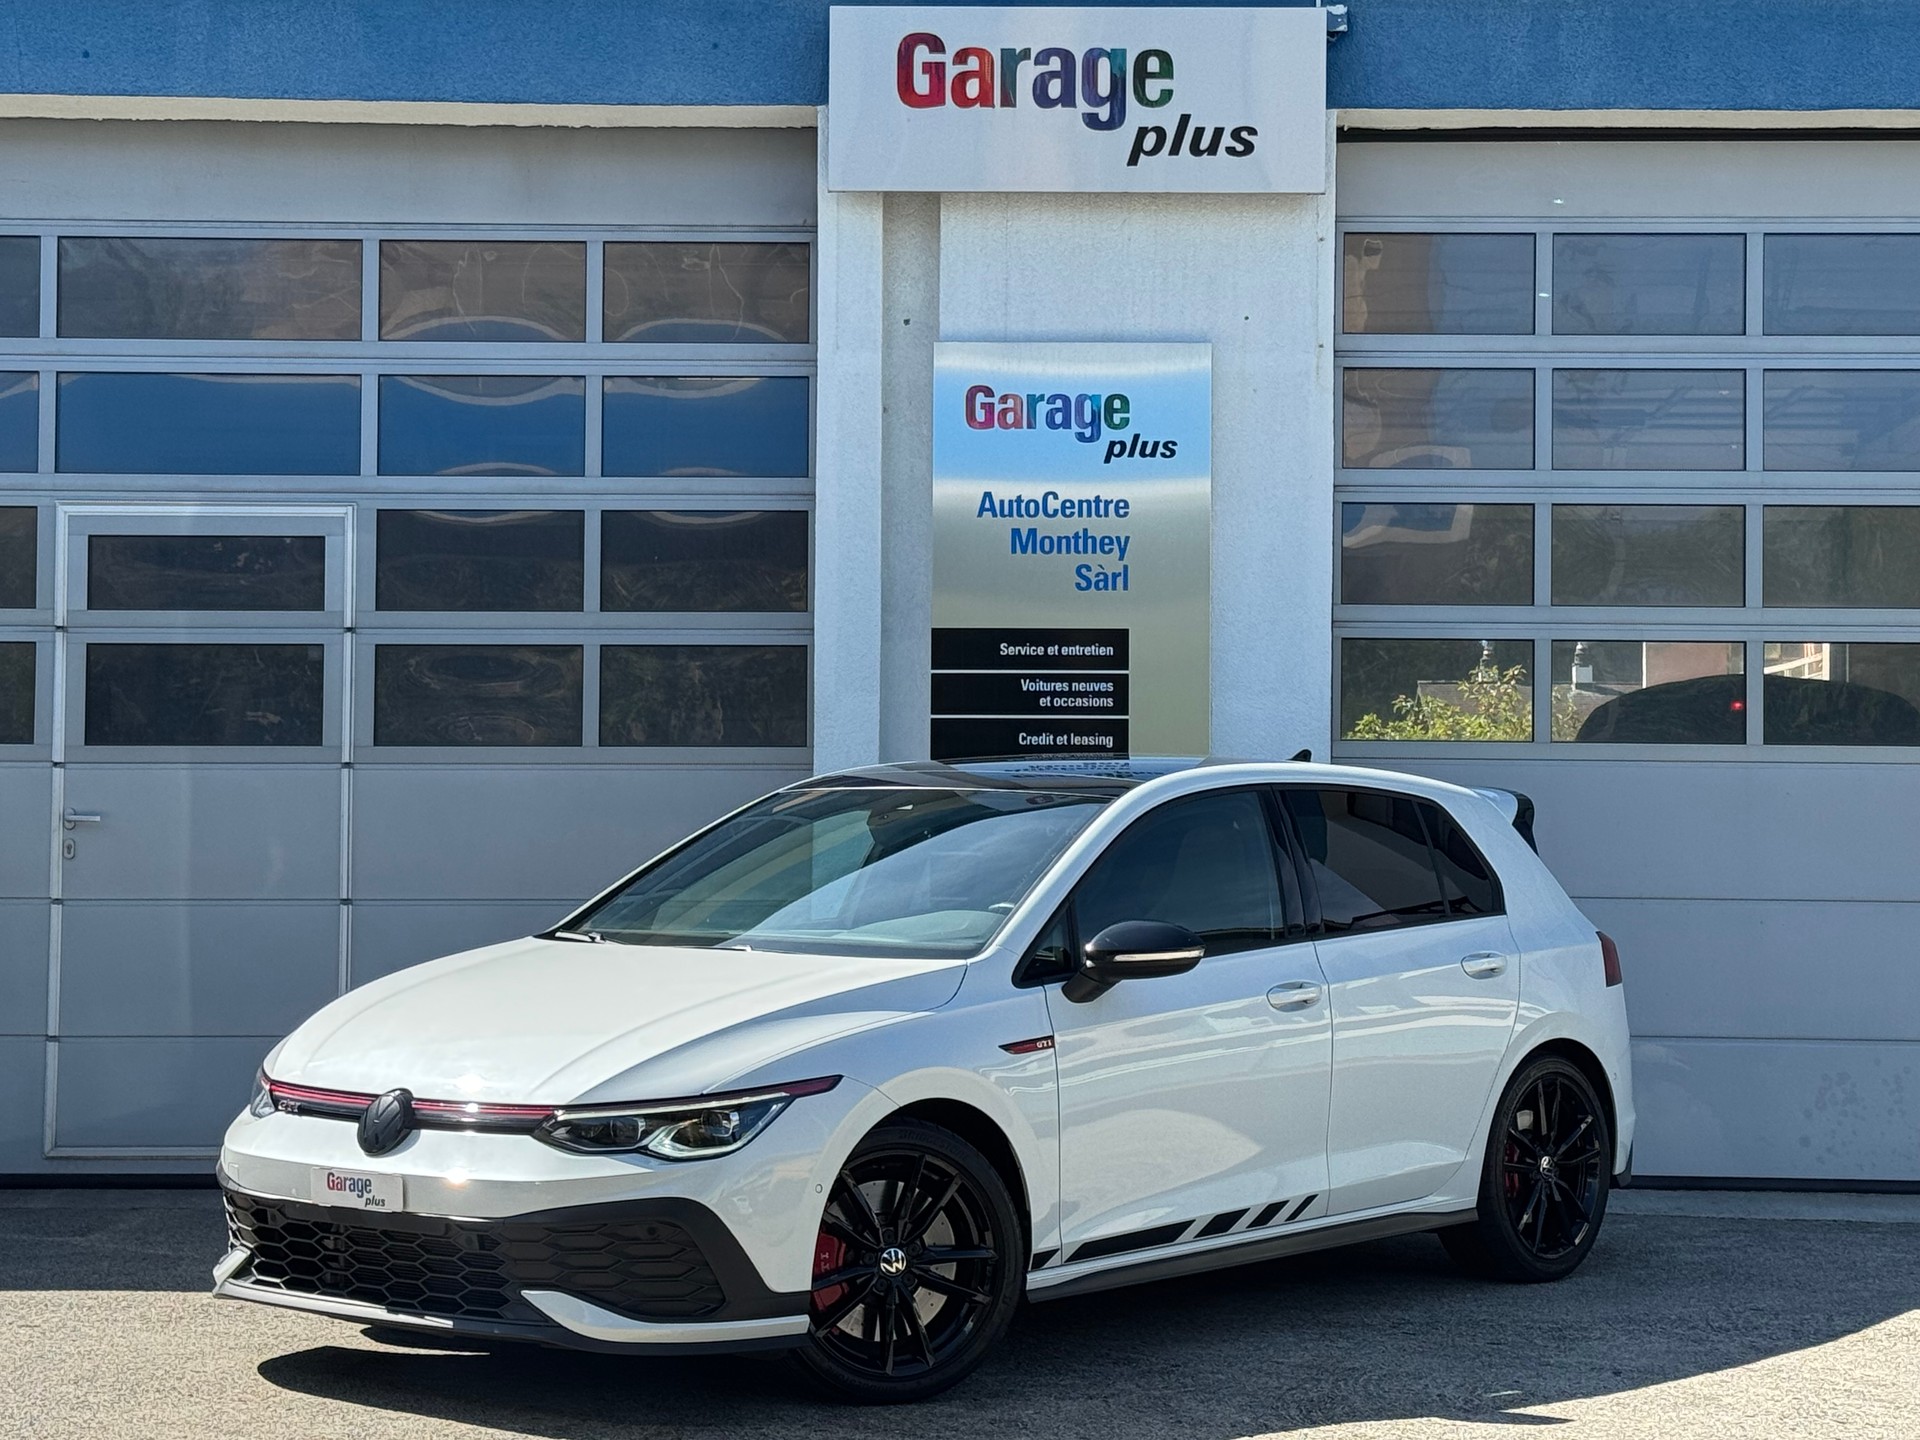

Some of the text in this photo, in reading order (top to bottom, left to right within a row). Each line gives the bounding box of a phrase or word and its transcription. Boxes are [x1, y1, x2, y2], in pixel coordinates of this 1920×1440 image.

[896, 32, 1175, 131] Garage
[1126, 114, 1258, 167] plus
[965, 384, 1130, 443] Garage
[1103, 434, 1178, 464] plus
[976, 491, 1130, 518] AutoCentre
[1010, 528, 1130, 561] Monthey
[1074, 563, 1129, 591] Sàrl
[1000, 643, 1114, 656] Service et entretien
[1020, 679, 1114, 692] Voitures neuves
[1039, 695, 1114, 707] et occasions
[1018, 732, 1113, 748] Credit et leasing
[1036, 1039, 1052, 1048] GTI
[327, 1172, 372, 1198] Garage
[364, 1195, 386, 1207] plus
